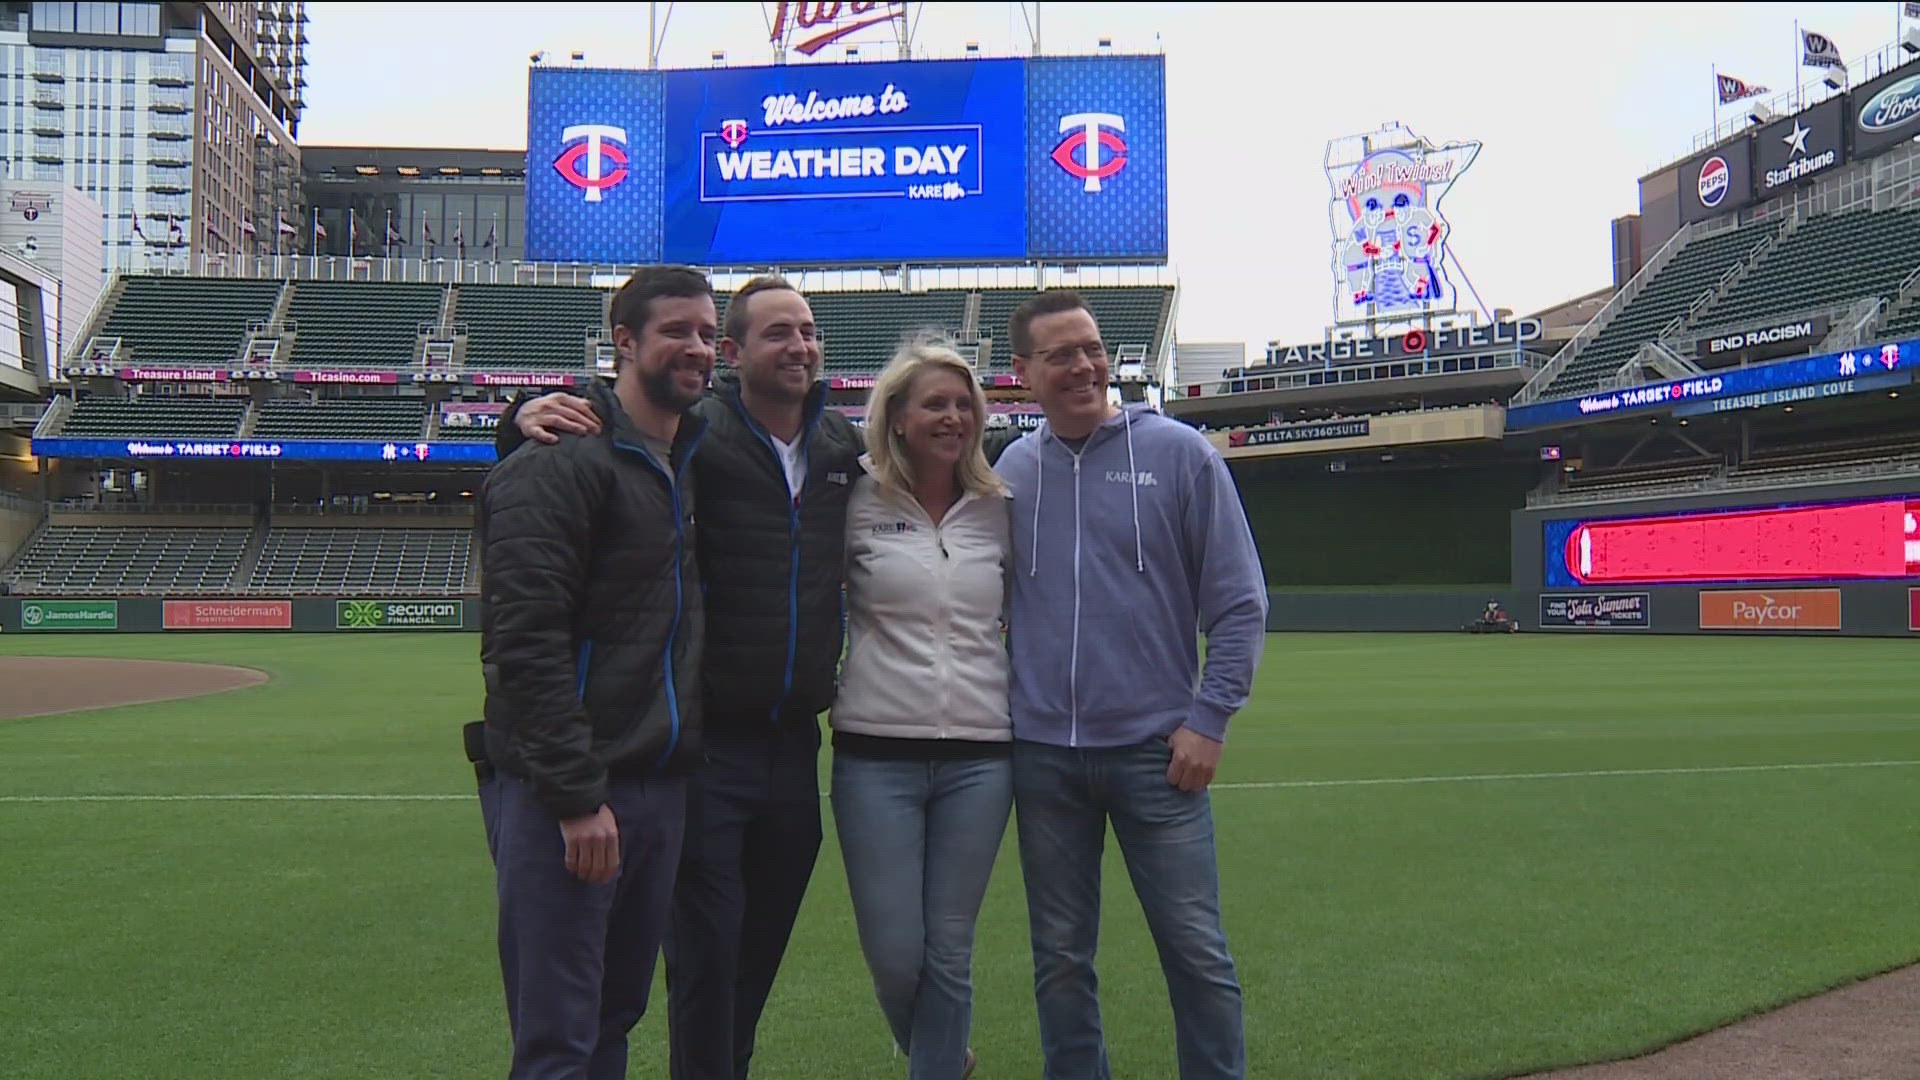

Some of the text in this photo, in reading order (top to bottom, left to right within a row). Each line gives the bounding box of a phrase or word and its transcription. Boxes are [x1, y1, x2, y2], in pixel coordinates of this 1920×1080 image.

[763, 83, 909, 126] Welcome to
[717, 144, 968, 181] WEATHER DAY
[1765, 151, 1835, 188] StarTribune
[1387, 160, 1453, 183] Twins!
[1700, 172, 1727, 190] PEPSI
[908, 184, 942, 199] KARE
[1265, 318, 1542, 365] TARGET FIELD
[1710, 322, 1812, 352] END RACISM
[132, 368, 216, 380] Treasure Island
[483, 374, 564, 385] Treasure Island
[841, 378, 875, 388] Treasu
[1622, 386, 1671, 407] TARGET
[1683, 378, 1722, 397] FIELD
[1713, 380, 1854, 411] TREASURE ISLAND COVE
[1260, 431, 1293, 441] DELTA
[176, 443, 230, 456] TARGET
[241, 443, 281, 456] FIELD
[195, 605, 283, 617] Schneiderman's
[388, 604, 454, 616] securian
[1547, 608, 1566, 616] YOUR
[1594, 596, 1640, 616] Summer
[1733, 601, 1802, 625] Paycor
[45, 610, 114, 620] JamesHardie
[388, 616, 436, 624] FINANCIAL
[1610, 611, 1642, 619] TICKETS
